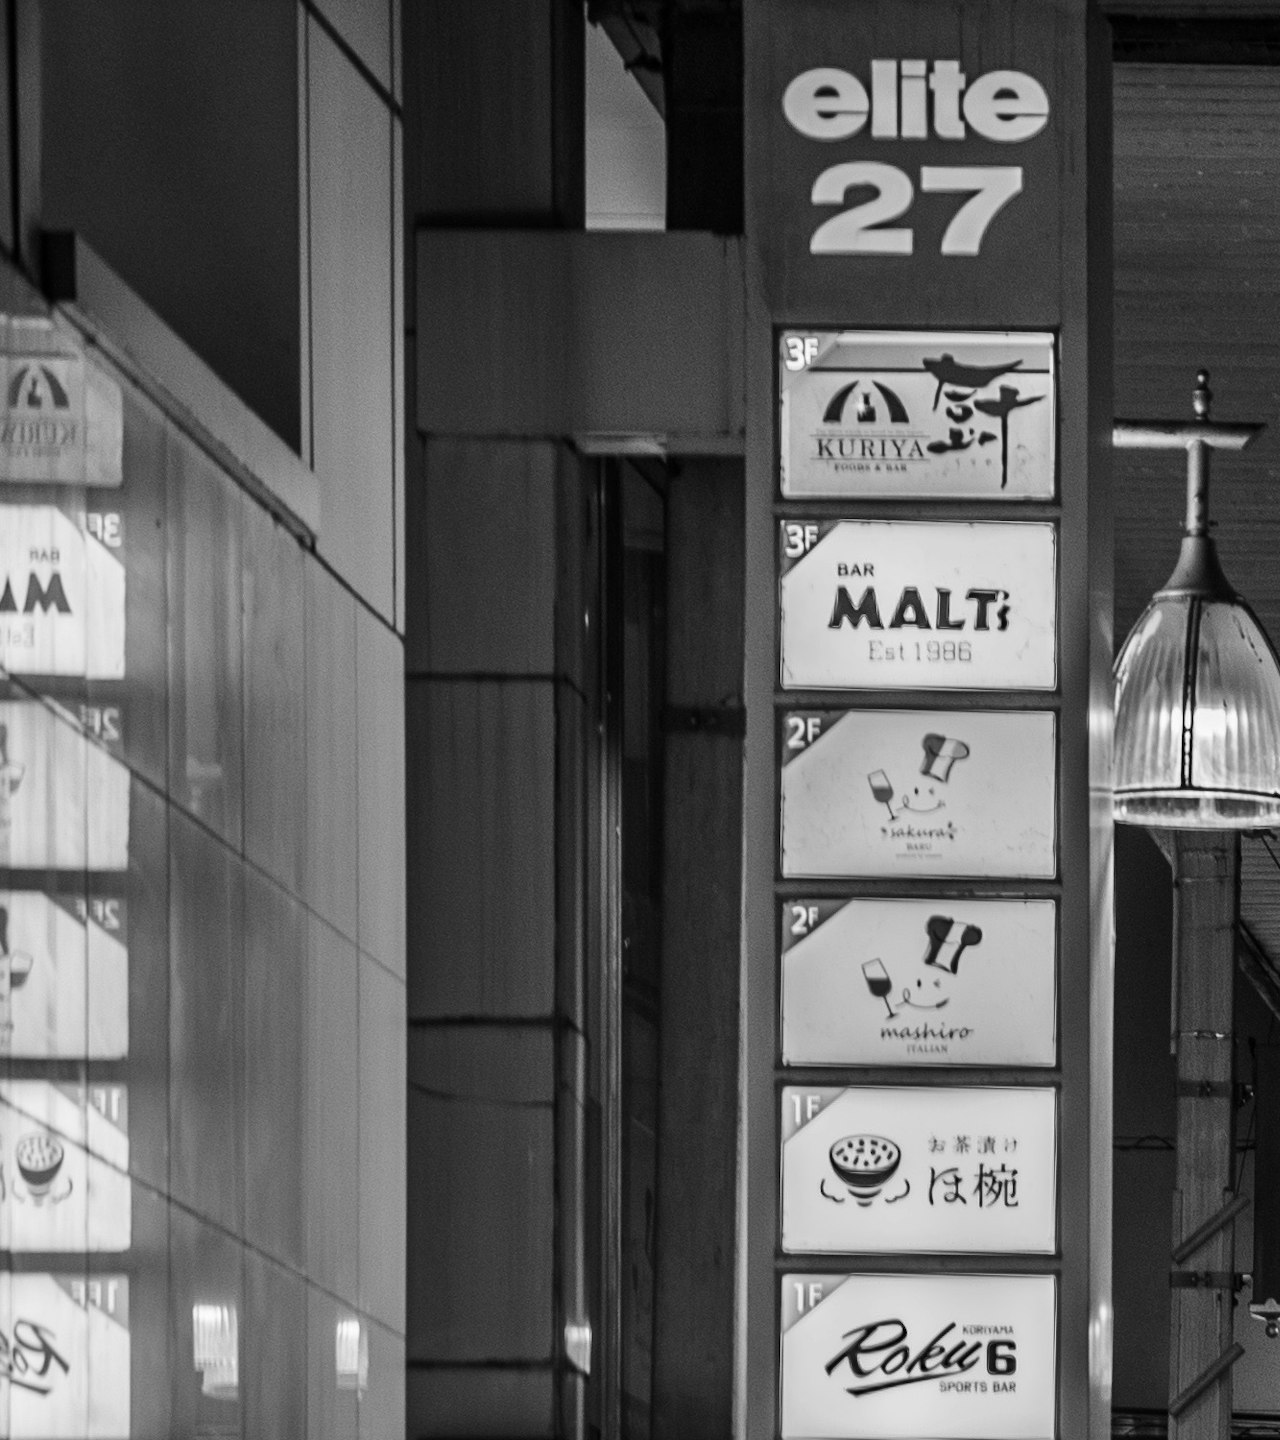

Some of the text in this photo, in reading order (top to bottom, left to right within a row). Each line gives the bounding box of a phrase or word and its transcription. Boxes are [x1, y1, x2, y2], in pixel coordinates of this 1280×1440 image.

[782, 58, 1050, 142] elite
[810, 162, 1024, 256] 27
[785, 337, 819, 371] 3F
[816, 437, 925, 458] KURIYA
[785, 525, 819, 559] 3F
[837, 562, 876, 578] BAR
[868, 640, 974, 663] Est 1986
[787, 717, 822, 750] 2F
[890, 823, 947, 840] sakura
[791, 905, 819, 936] 2F
[881, 1021, 975, 1042] mashiro
[906, 1043, 950, 1055] ITALIAN
[791, 1093, 822, 1127] 1F
[928, 1134, 1019, 1155] お茶漬け
[793, 1282, 823, 1313] 1F
[962, 1324, 1015, 1336] KORIYAMA
[825, 1317, 1018, 1379] Roku 6
[939, 1381, 1017, 1394] SPORTS BAR
